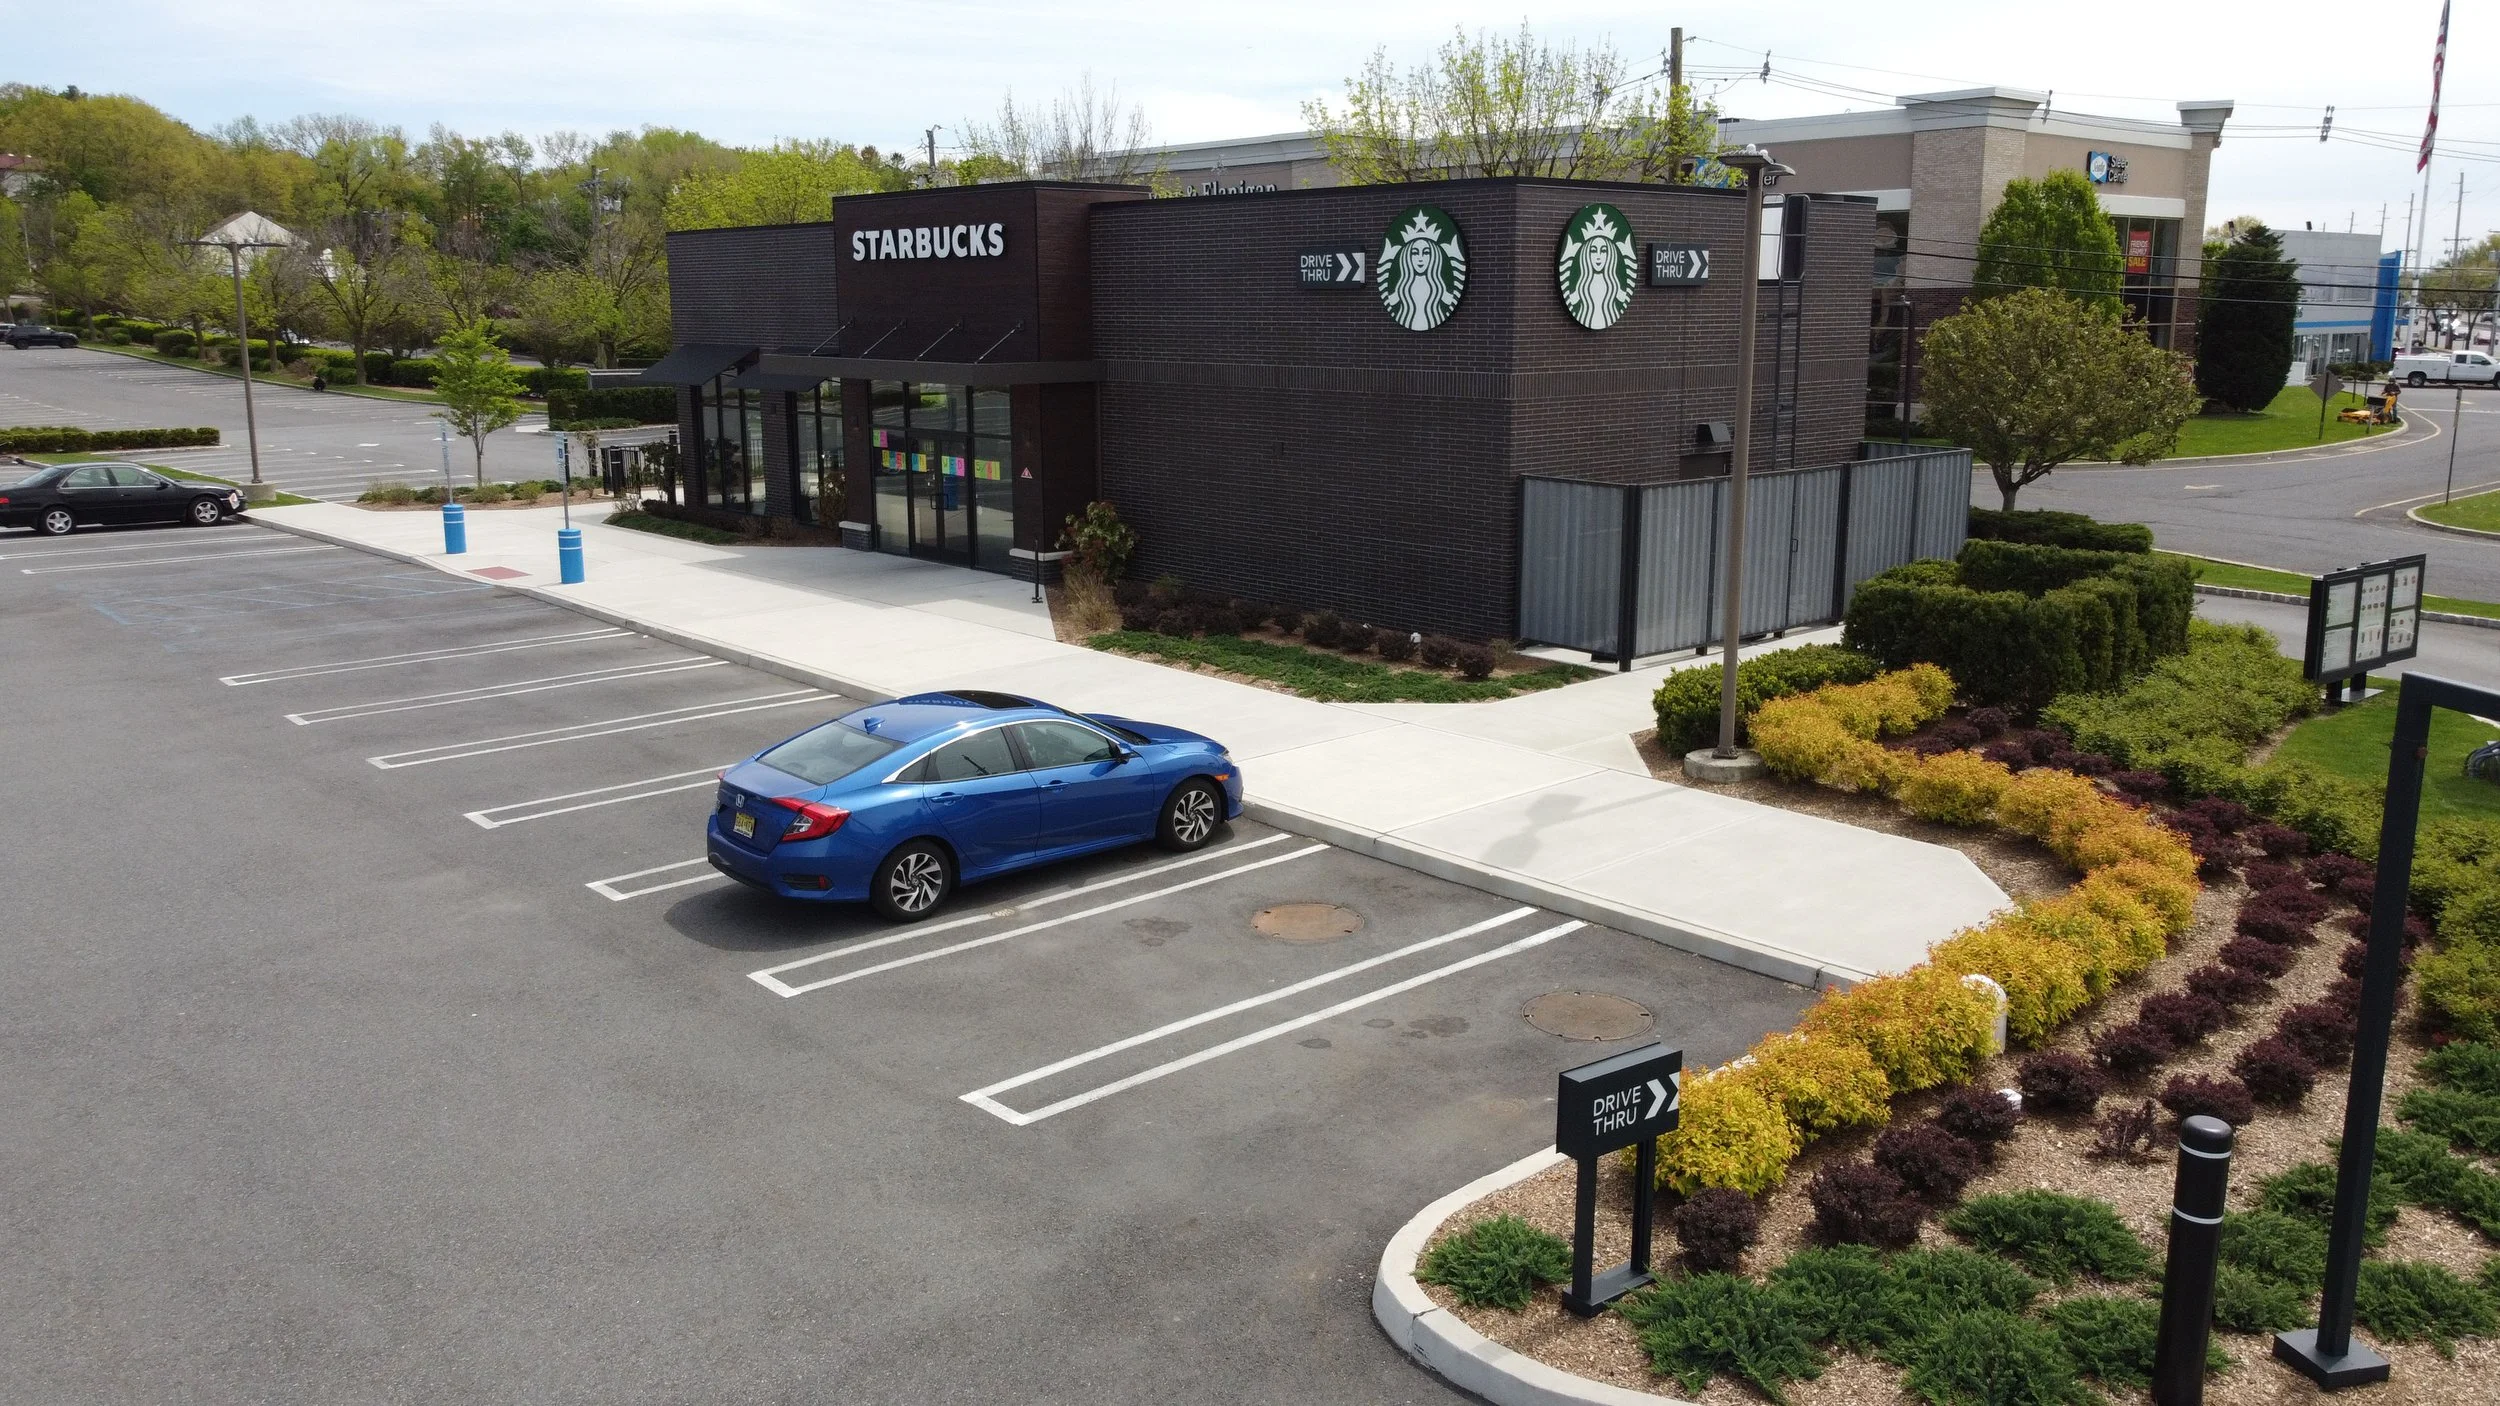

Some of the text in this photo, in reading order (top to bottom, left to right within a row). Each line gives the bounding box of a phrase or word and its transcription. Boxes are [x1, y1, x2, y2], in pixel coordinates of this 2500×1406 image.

[852, 222, 1004, 262] STARBUCKS
[1300, 254, 1333, 268] DRIVE
[1656, 250, 1685, 264] DRIVE
[2127, 256, 2147, 267] SALE
[1300, 268, 1331, 282] THRU
[1656, 264, 1683, 278] THRU
[1593, 1085, 1642, 1117] DRIVE
[1593, 1106, 1637, 1136] THRU
